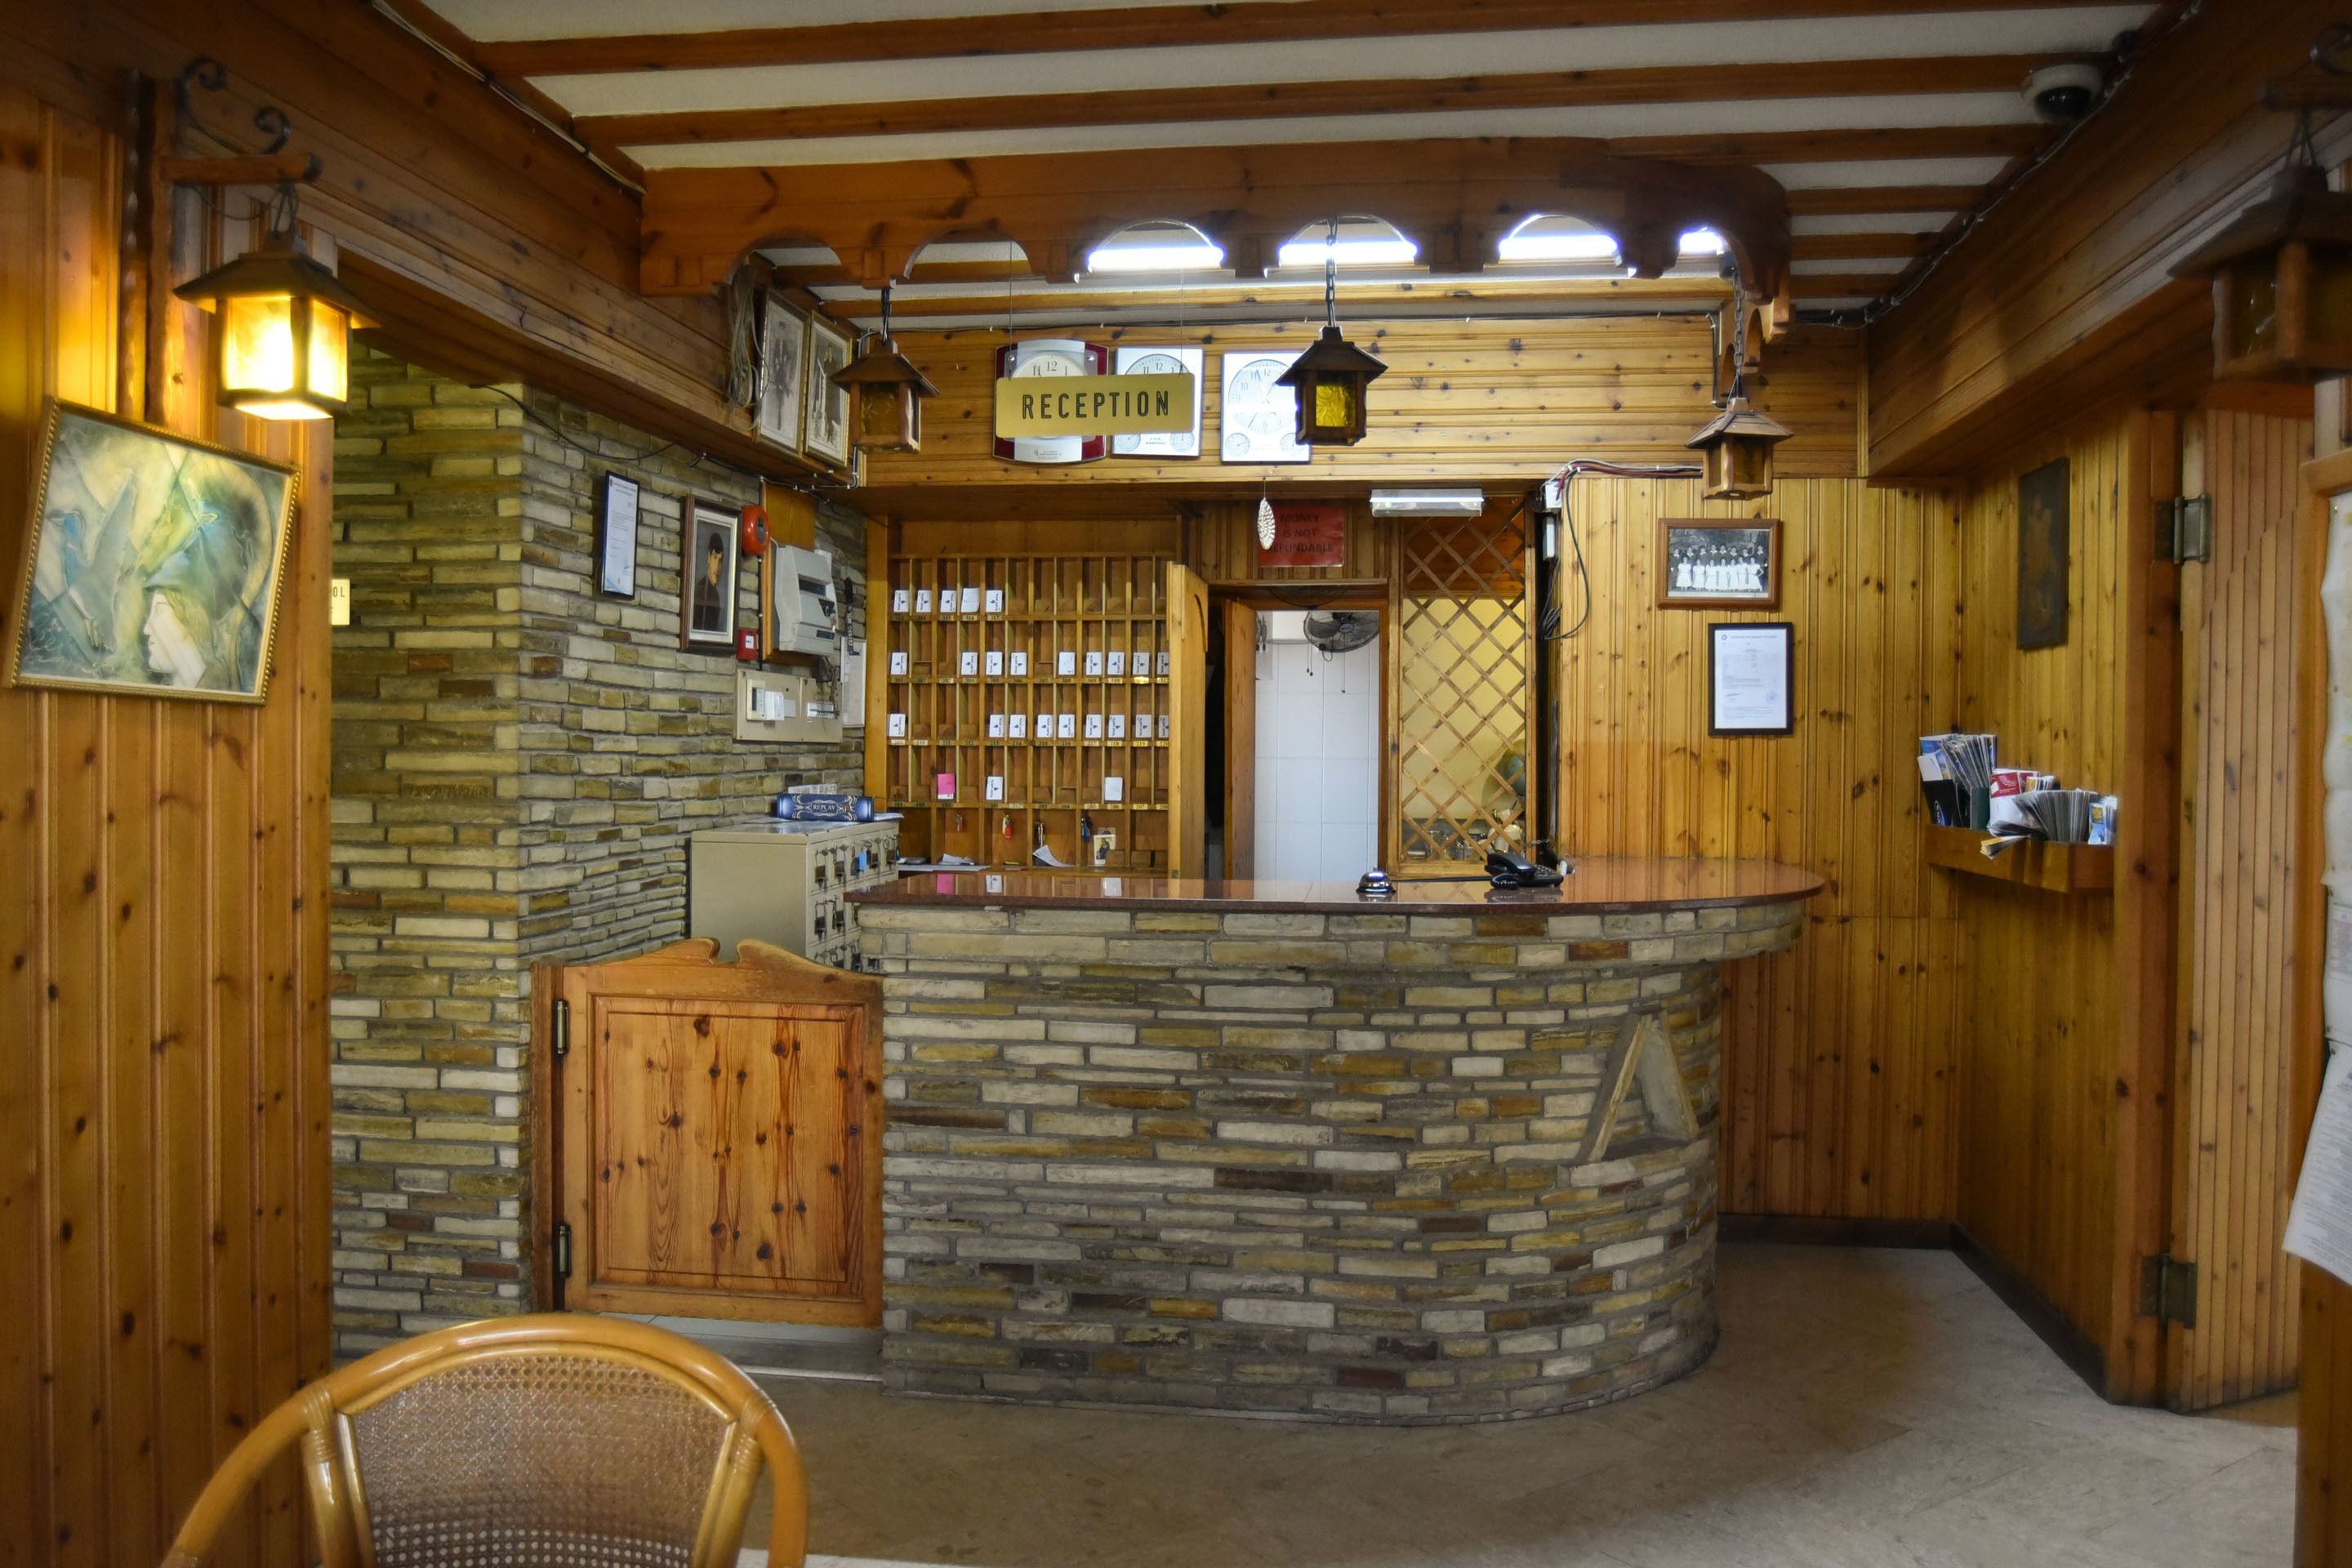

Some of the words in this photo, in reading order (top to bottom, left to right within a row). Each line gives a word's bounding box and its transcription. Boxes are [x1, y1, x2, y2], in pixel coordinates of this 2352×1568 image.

[1047, 361, 1058, 372] 12
[1156, 363, 1163, 371] 12
[1251, 372, 1257, 380] 11
[1241, 382, 1249, 390] 10
[1022, 390, 1169, 420] RECEPTION
[1281, 514, 1320, 523] MONEY
[1269, 543, 1334, 552] EFUNDABLE
